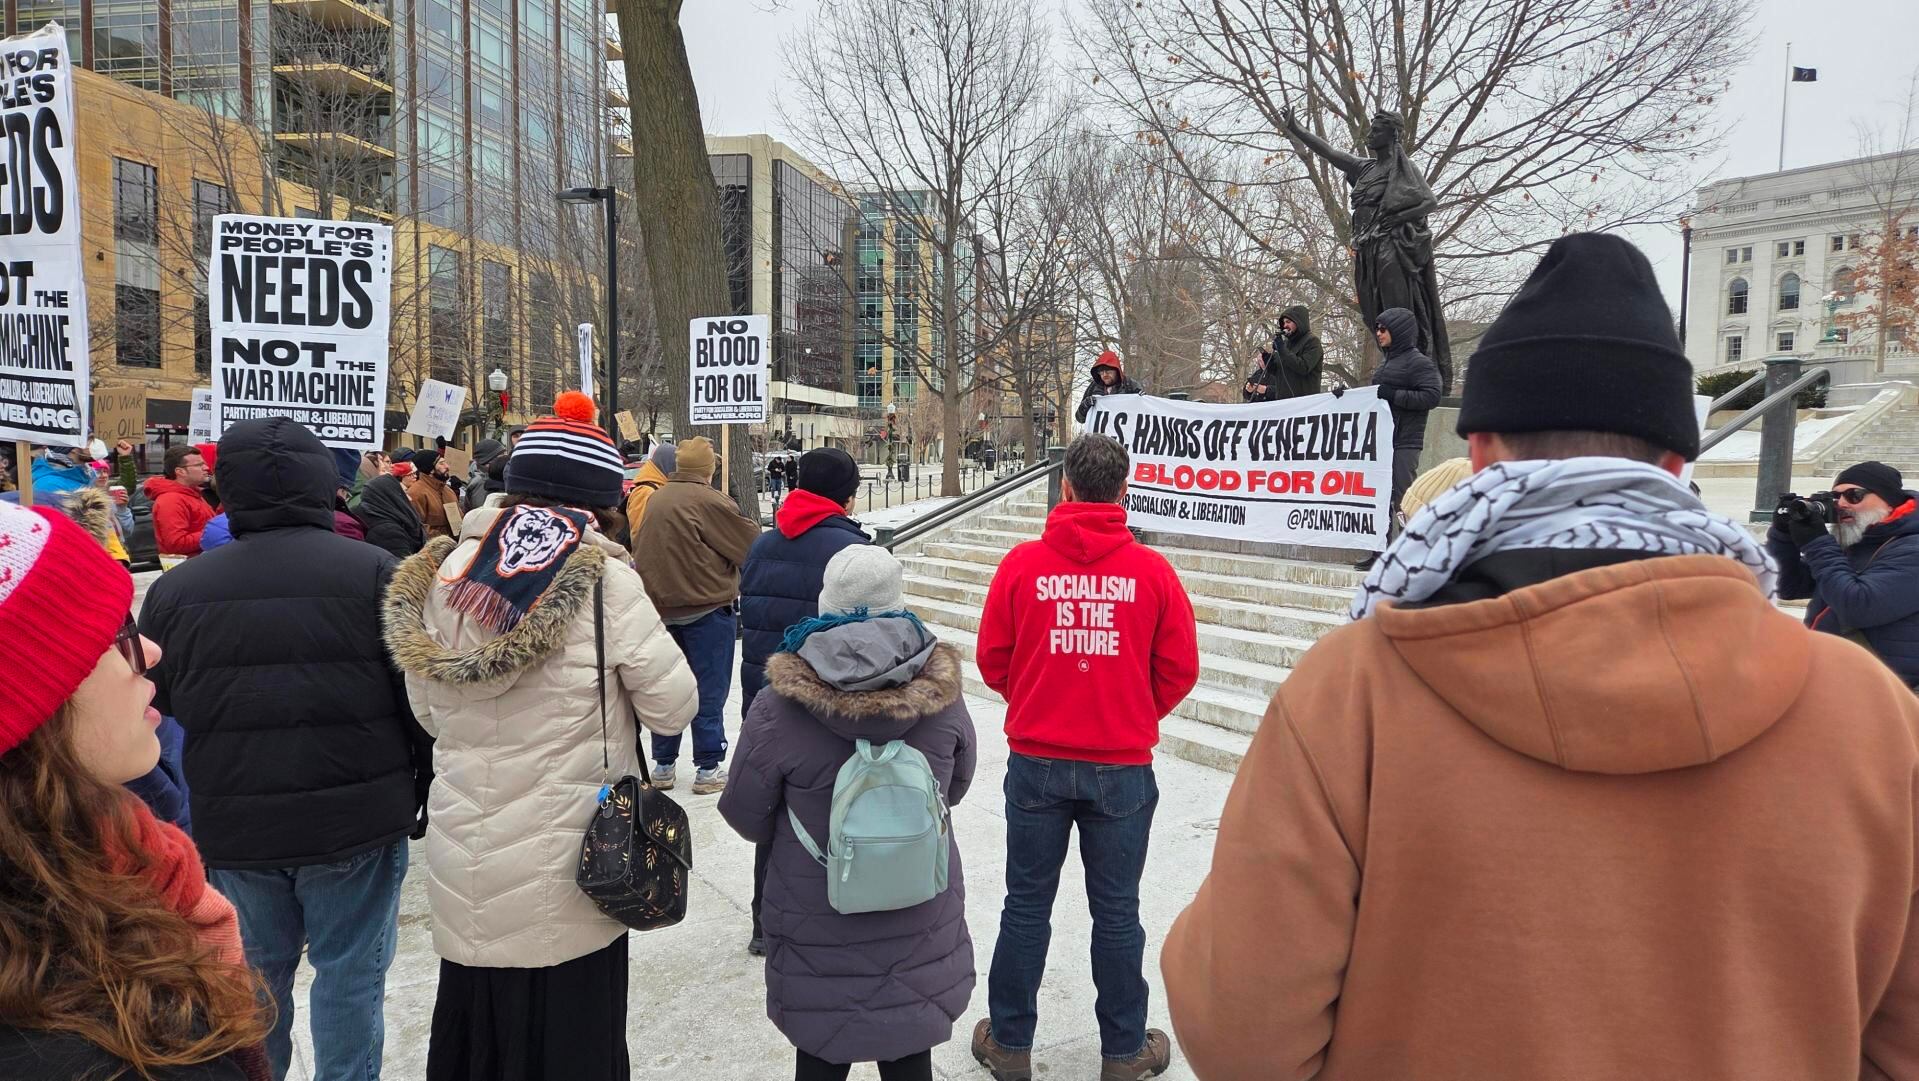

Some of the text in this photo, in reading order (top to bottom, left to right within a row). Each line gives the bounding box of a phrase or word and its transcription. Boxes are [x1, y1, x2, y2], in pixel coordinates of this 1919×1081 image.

[5, 48, 58, 77] FOR
[221, 221, 374, 241] MONEY FOR
[220, 236, 374, 258] PEOPLE'S
[34, 291, 68, 308] THE
[221, 254, 373, 329] NEEDS
[707, 320, 748, 335] NO
[222, 337, 375, 372] NOT THE
[696, 336, 760, 368] BLOOD
[21, 381, 30, 402] &
[30, 382, 74, 406] LIBERATION
[222, 368, 375, 407] WAR MACHINE
[694, 373, 762, 403] FOR OIL
[97, 394, 143, 414] NO WAR
[223, 406, 250, 419] PARTY
[250, 408, 267, 419] FOR
[310, 411, 323, 423] &
[324, 412, 372, 426] LIBERATION
[694, 412, 761, 420] PSLWEB.ORG
[1132, 413, 1203, 459] HANDS
[1204, 419, 1249, 461] OFF
[1248, 412, 1377, 461] VENEZUELA
[1134, 463, 1376, 497] BLOOD FOR OIL
[1131, 493, 1178, 517] SOCIALISM
[1178, 501, 1190, 519] &
[1191, 502, 1246, 525] LIBERATION
[1287, 509, 1376, 535] @PSLNATIONAL
[1036, 575, 1136, 603] SOCIALISM
[1056, 602, 1115, 628] IS THE
[1050, 629, 1120, 656] FUTURE
